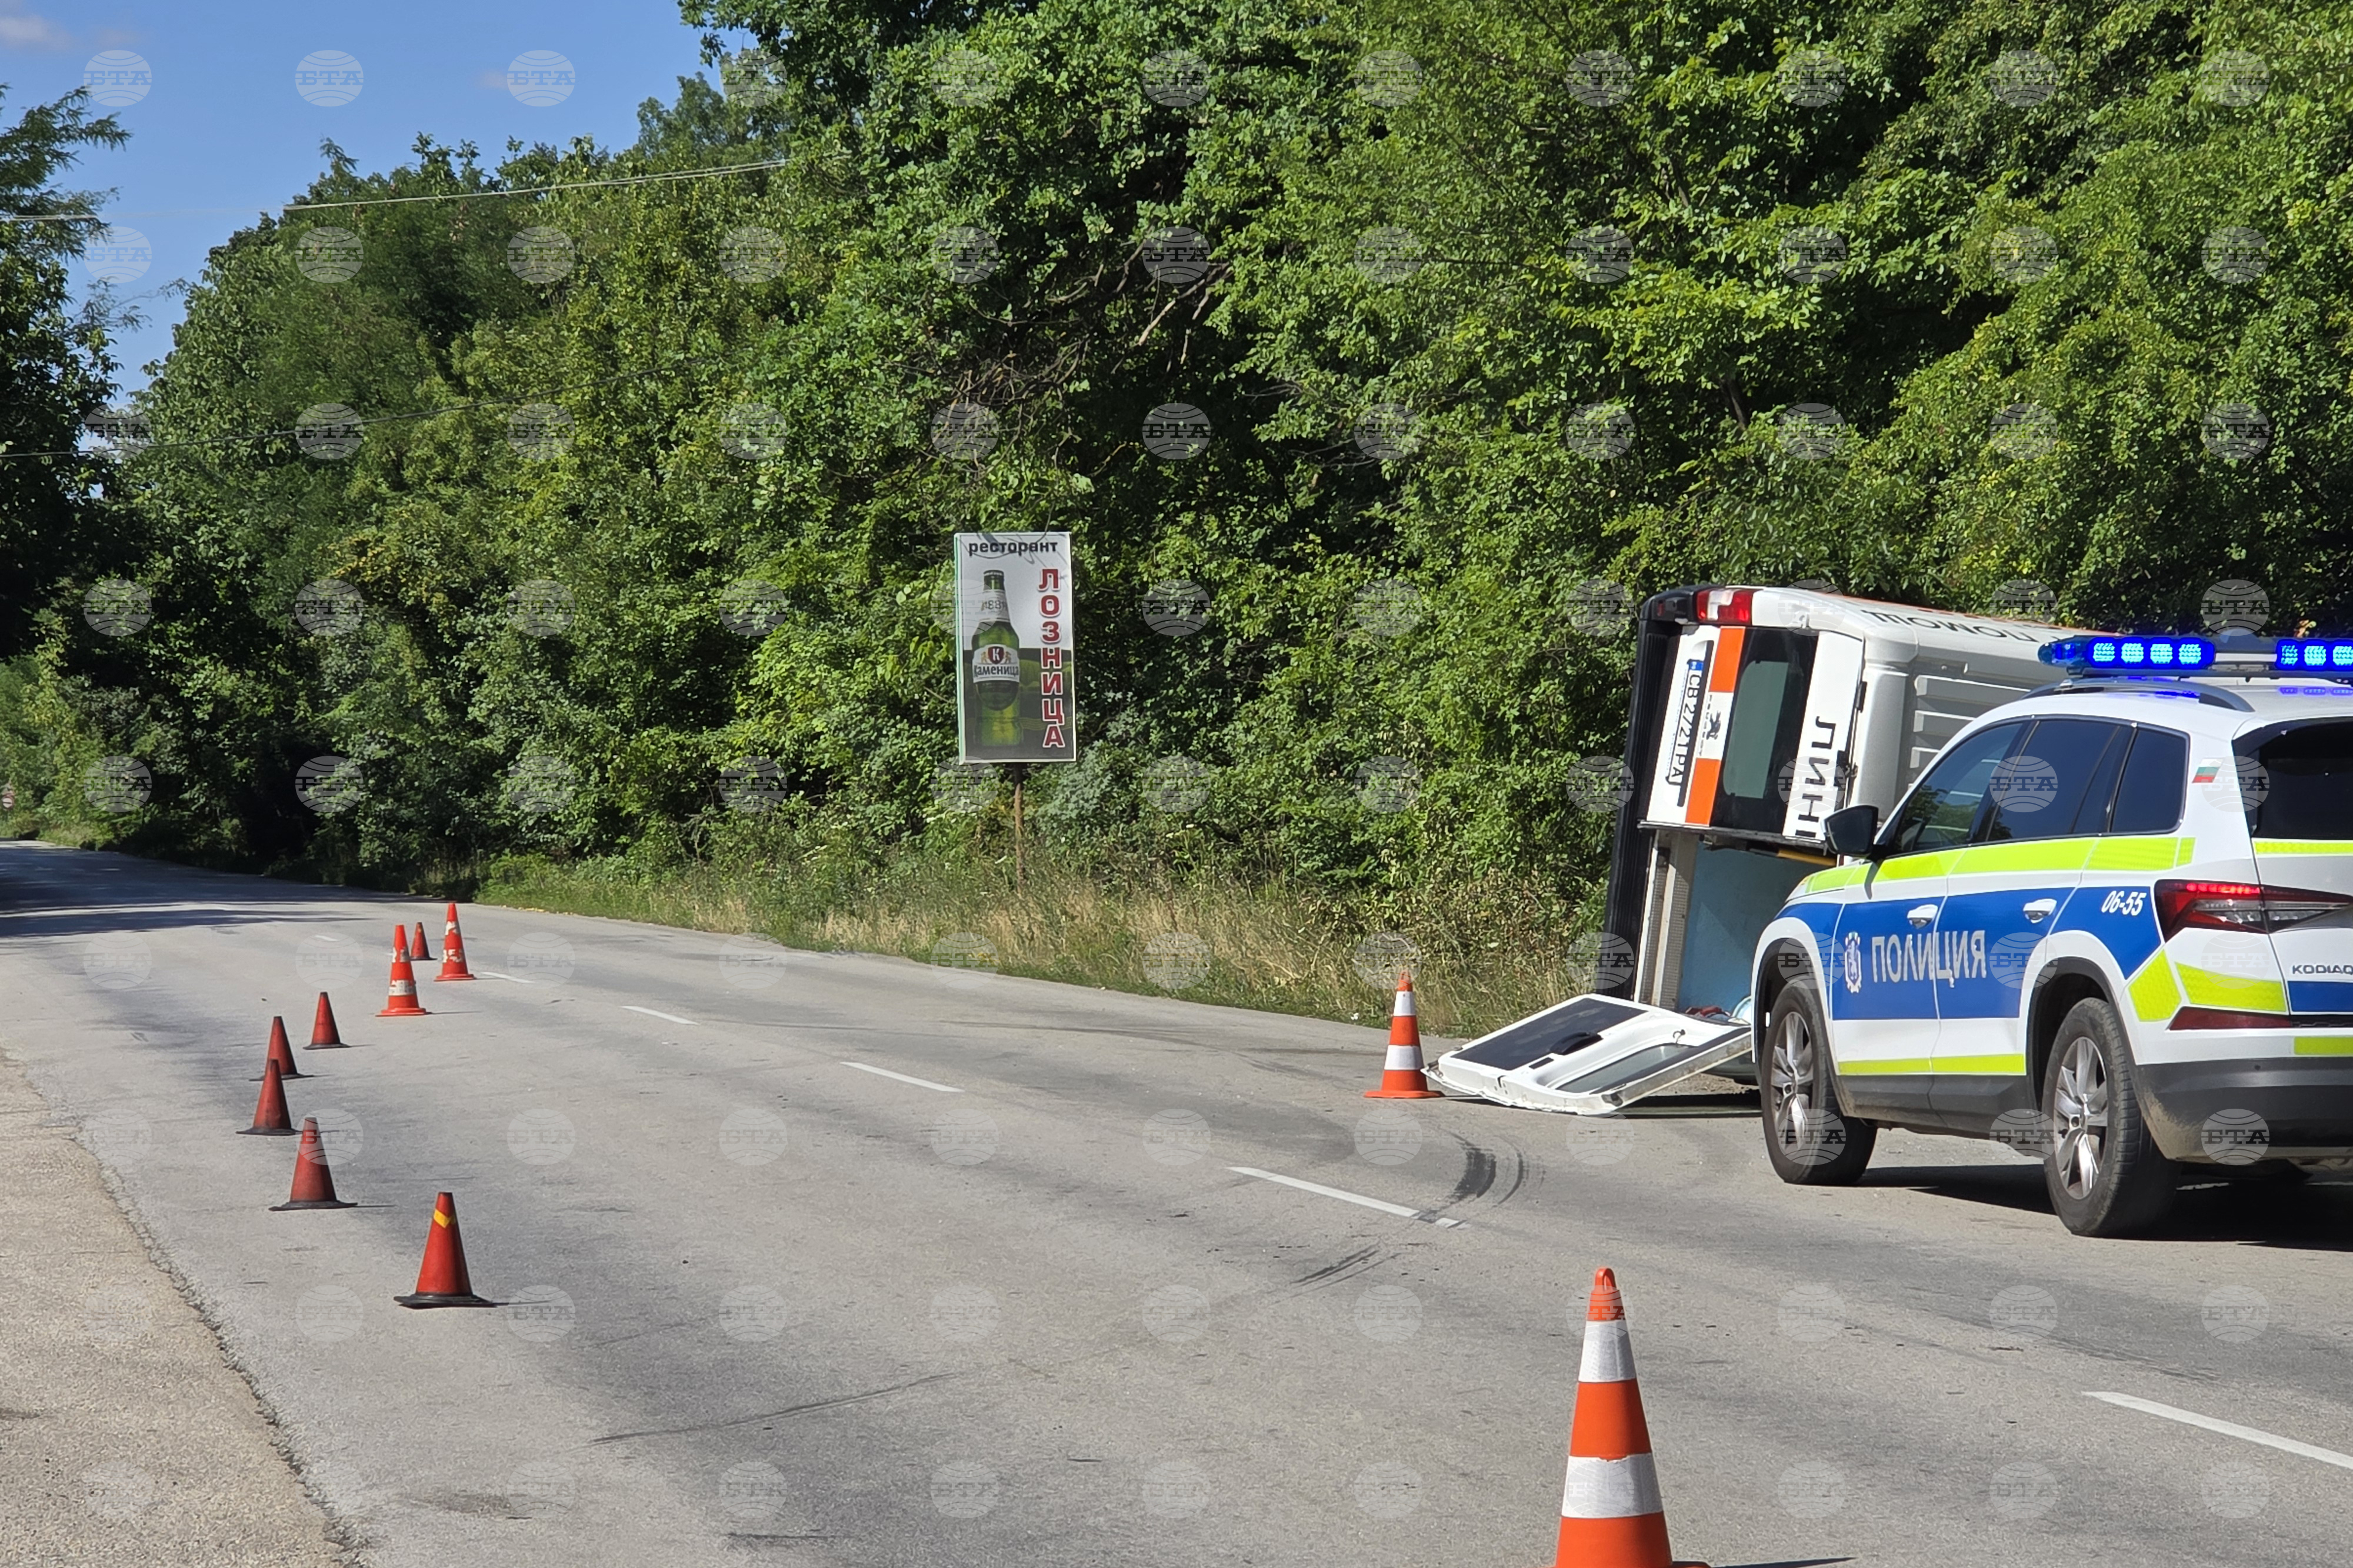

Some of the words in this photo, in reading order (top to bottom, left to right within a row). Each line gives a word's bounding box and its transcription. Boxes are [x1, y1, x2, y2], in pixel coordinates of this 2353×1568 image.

[969, 542, 1058, 556] ресторант
[1038, 568, 1064, 748] ЛОЗНИЦА
[974, 665, 1019, 678] Каменица
[2101, 890, 2147, 916] 06-55
[1872, 930, 1987, 988] ПОЛИЦИЯ
[2292, 965, 2353, 975] KODIAQ
